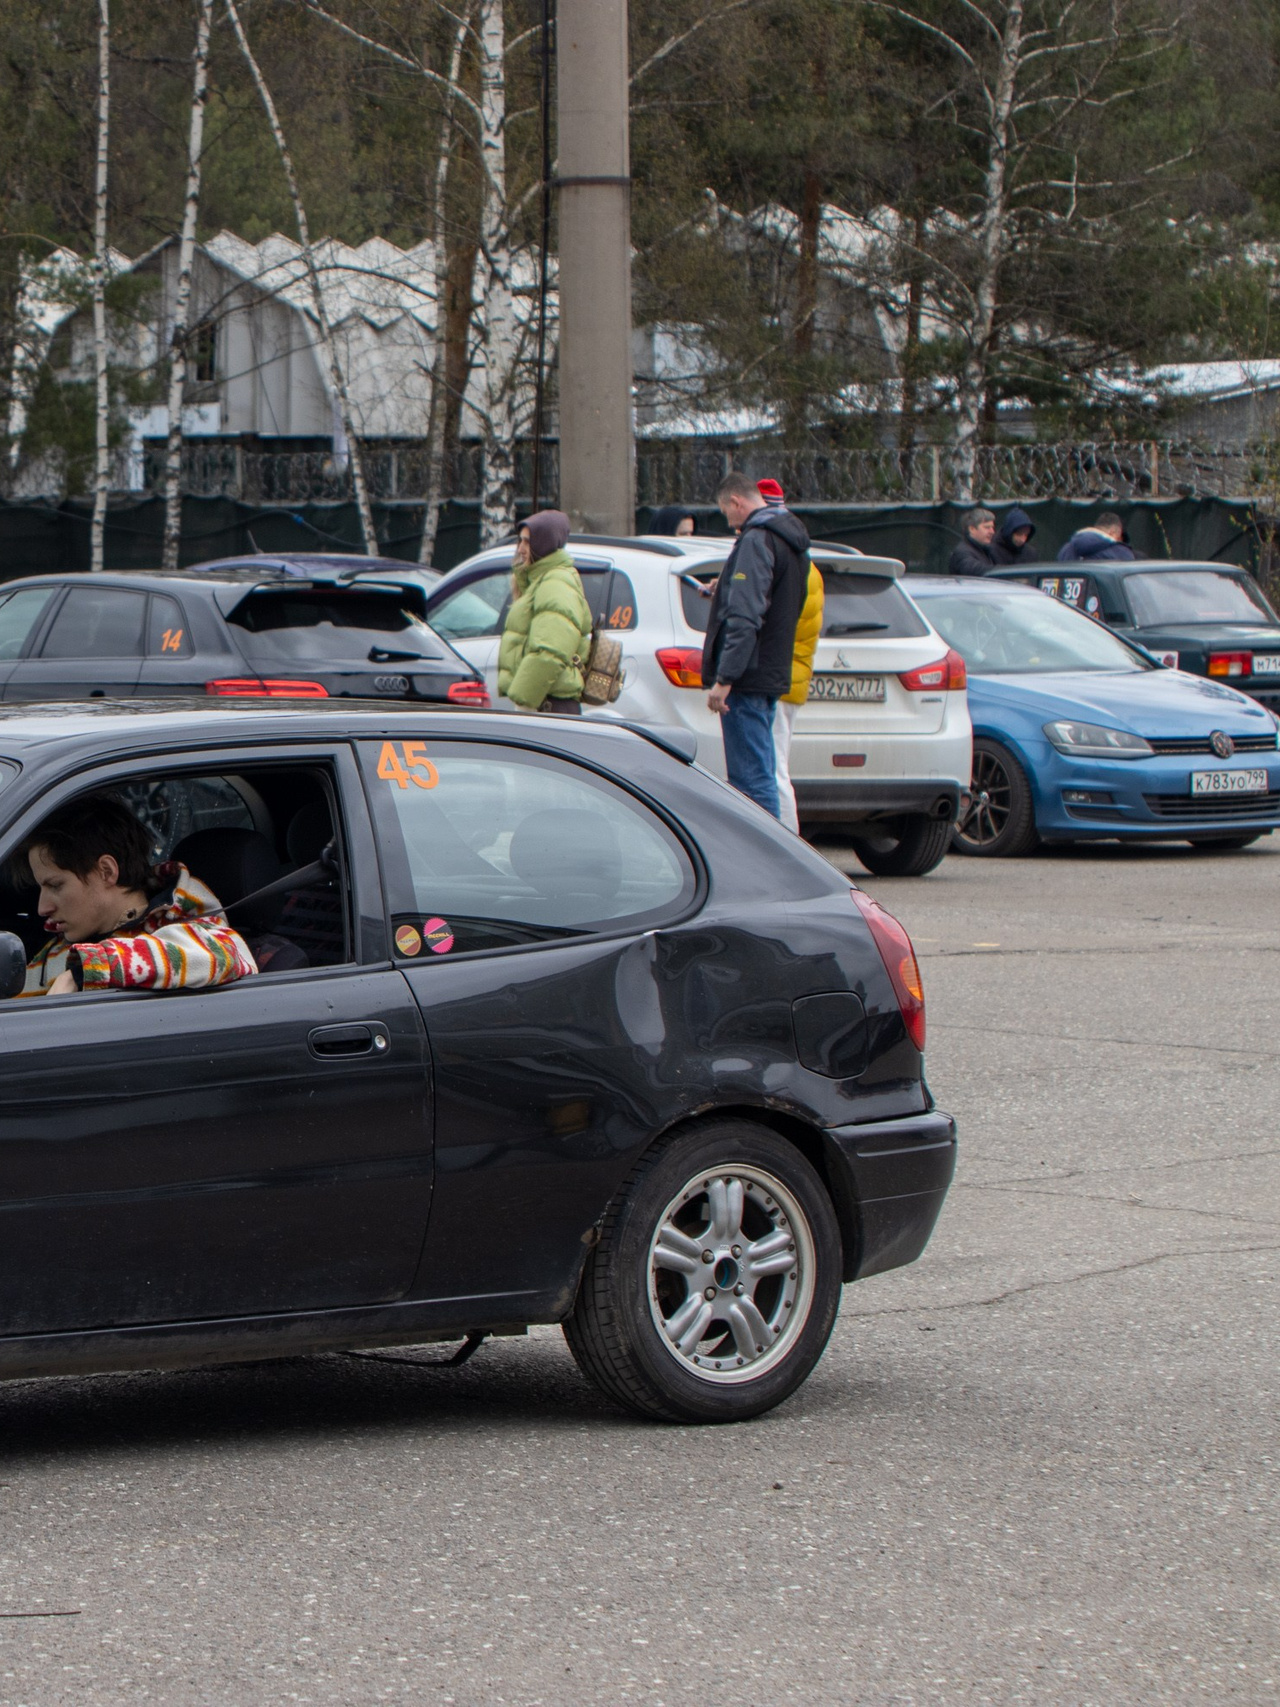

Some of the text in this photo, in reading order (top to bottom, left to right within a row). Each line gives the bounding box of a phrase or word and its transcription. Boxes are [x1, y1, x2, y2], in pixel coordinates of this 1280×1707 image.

[1063, 582, 1082, 600] 30
[609, 605, 633, 629] 49
[161, 628, 184, 653] 14
[376, 740, 440, 790] 45
